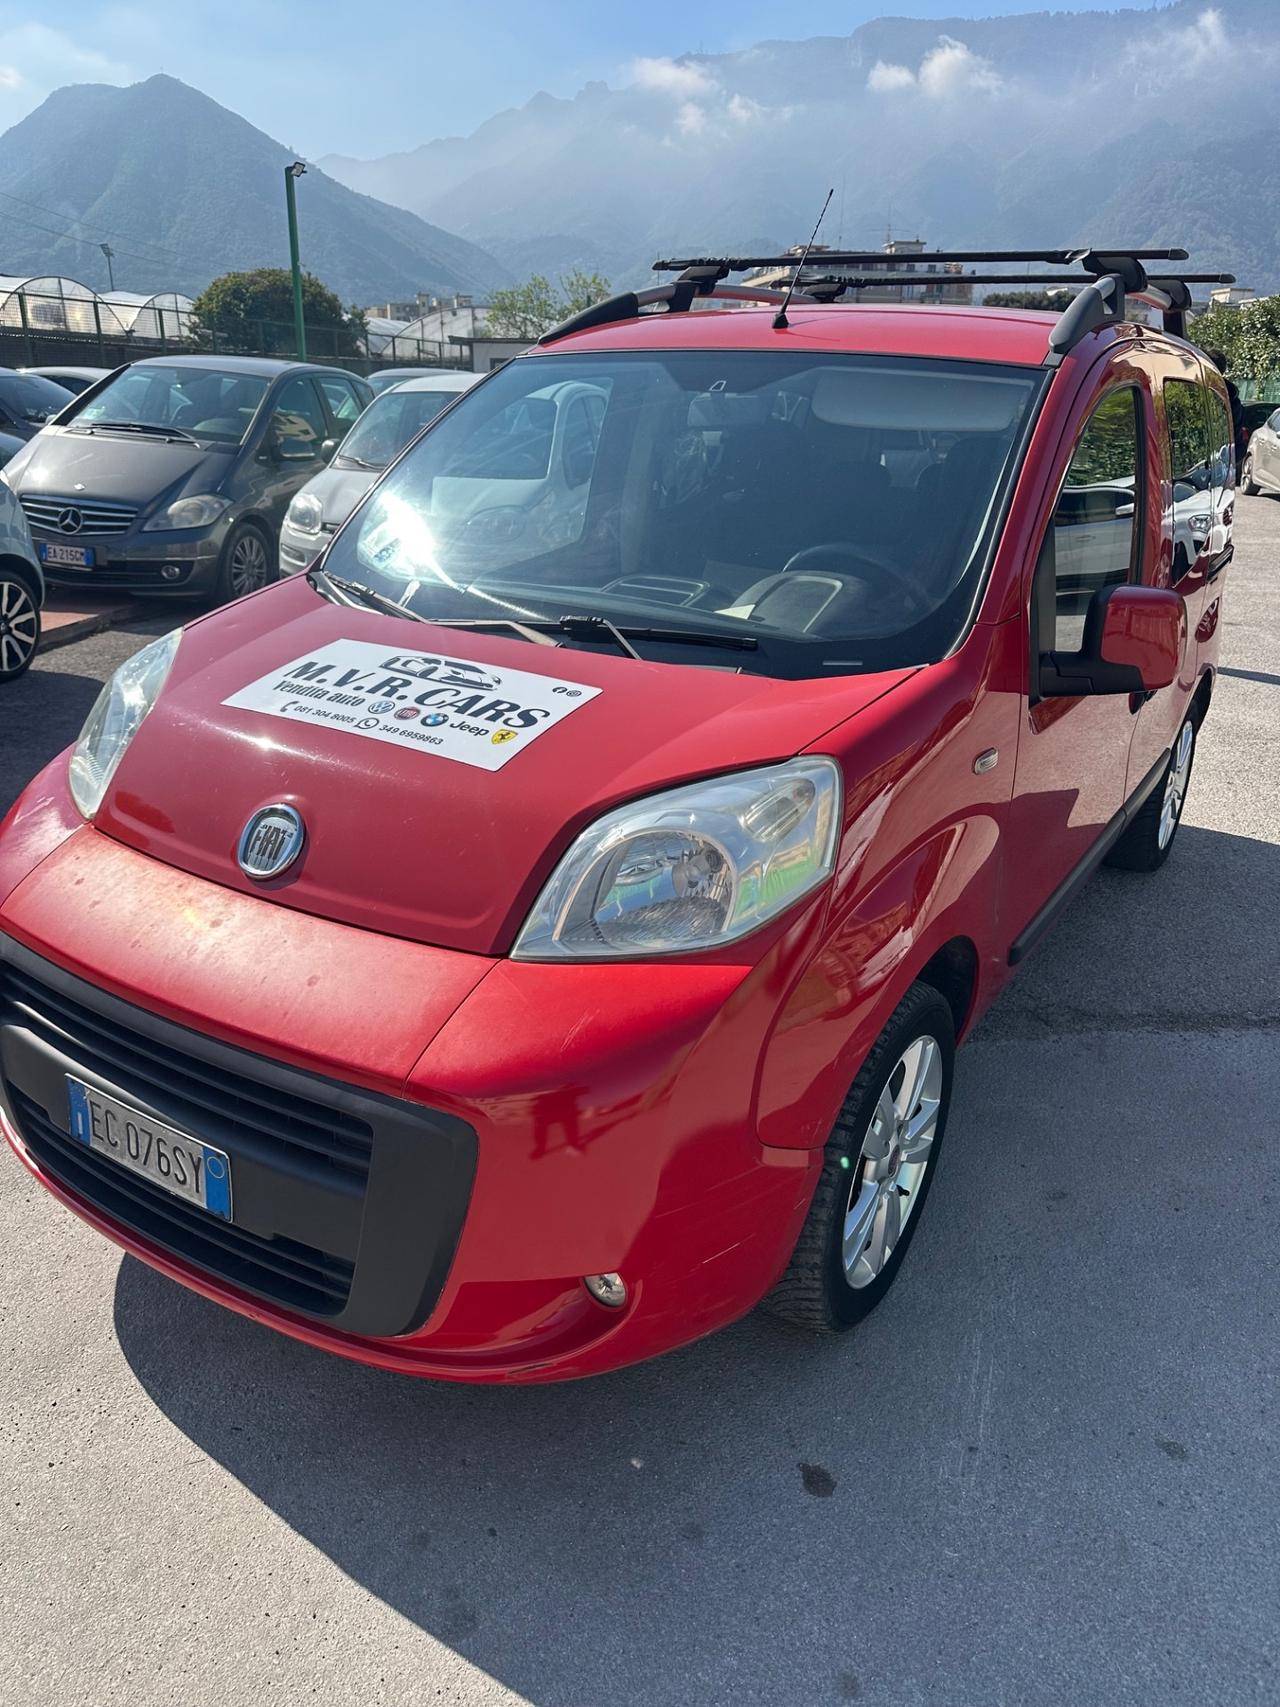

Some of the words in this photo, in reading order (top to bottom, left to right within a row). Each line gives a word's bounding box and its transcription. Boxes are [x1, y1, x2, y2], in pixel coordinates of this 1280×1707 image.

[273, 680, 331, 699] Vendita
[326, 692, 366, 707] auto
[294, 705, 311, 714] 081
[312, 709, 330, 718] 304
[330, 713, 358, 724] 8005
[379, 724, 399, 734] 349
[399, 729, 444, 745] 6959863
[450, 721, 490, 737] Jeep
[249, 824, 293, 860] FIAT
[90, 1100, 118, 1147] EC
[126, 1122, 202, 1194] 076SY
